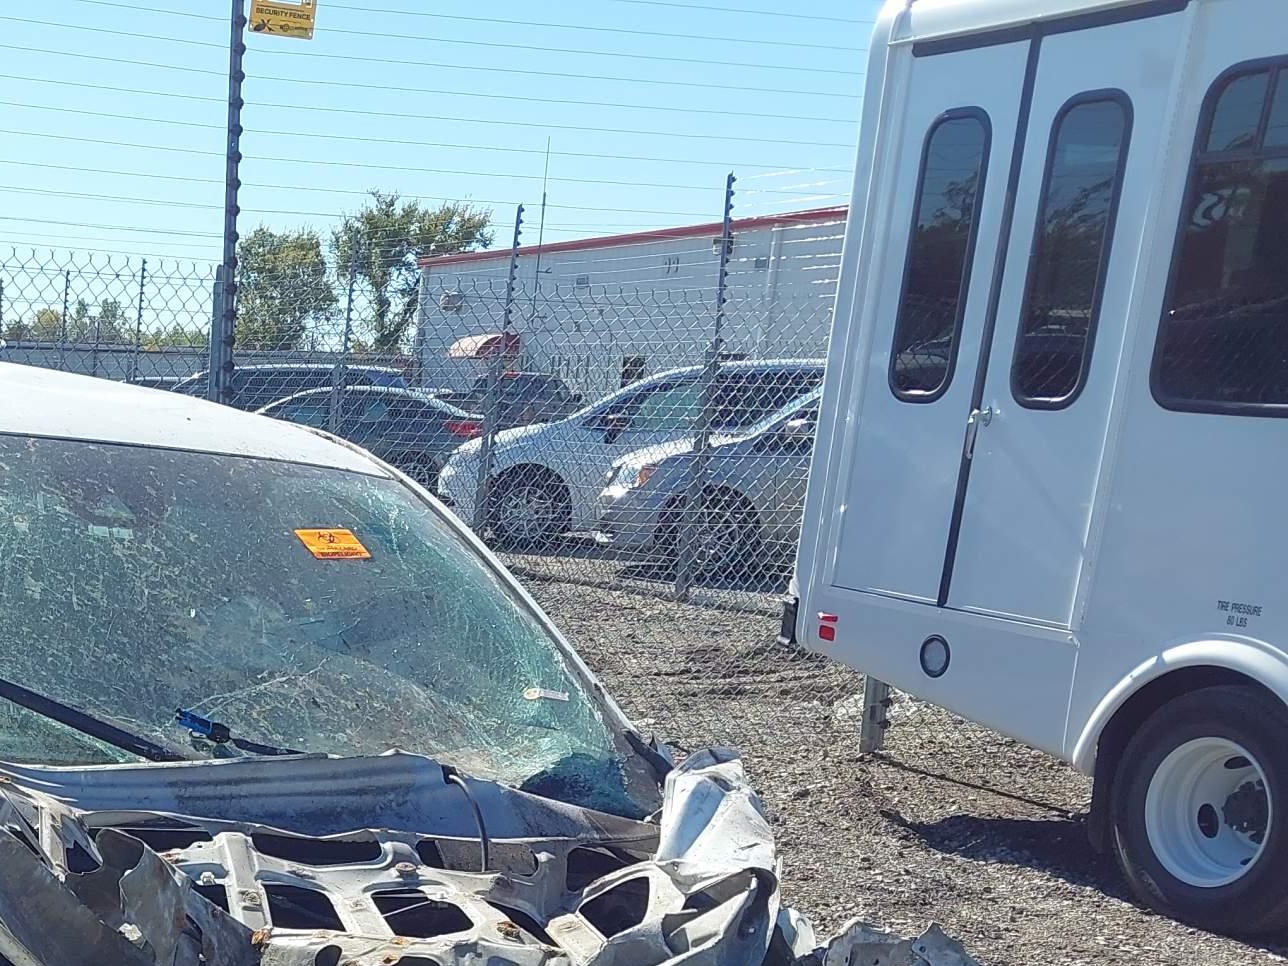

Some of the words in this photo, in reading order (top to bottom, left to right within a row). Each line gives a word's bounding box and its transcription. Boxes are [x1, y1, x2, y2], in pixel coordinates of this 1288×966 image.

[256, 7, 288, 18] SECURITY
[289, 12, 311, 21] FENCE
[1217, 600, 1231, 612] TIRE
[1231, 602, 1263, 617] PRESSURE
[1235, 616, 1248, 628] LBS
